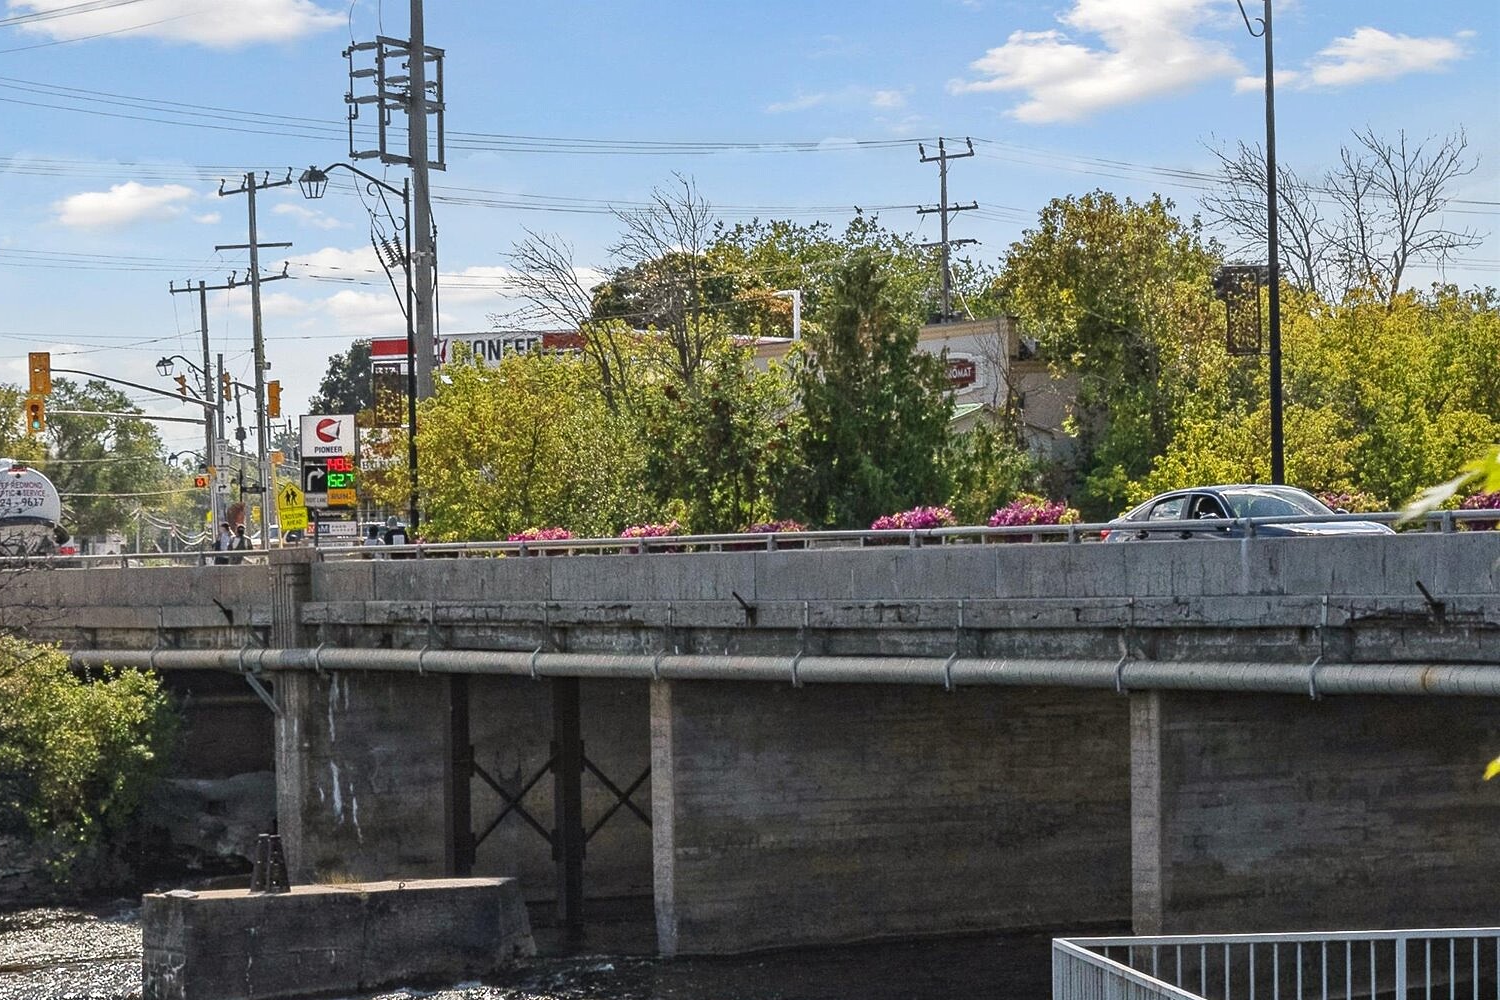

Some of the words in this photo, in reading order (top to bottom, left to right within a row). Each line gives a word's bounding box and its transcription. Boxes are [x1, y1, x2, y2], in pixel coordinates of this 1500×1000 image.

[452, 338, 540, 361] ONEE
[314, 446, 343, 454] PIONEER
[11, 481, 43, 489] REDMOND
[327, 473, 354, 487] 152.7
